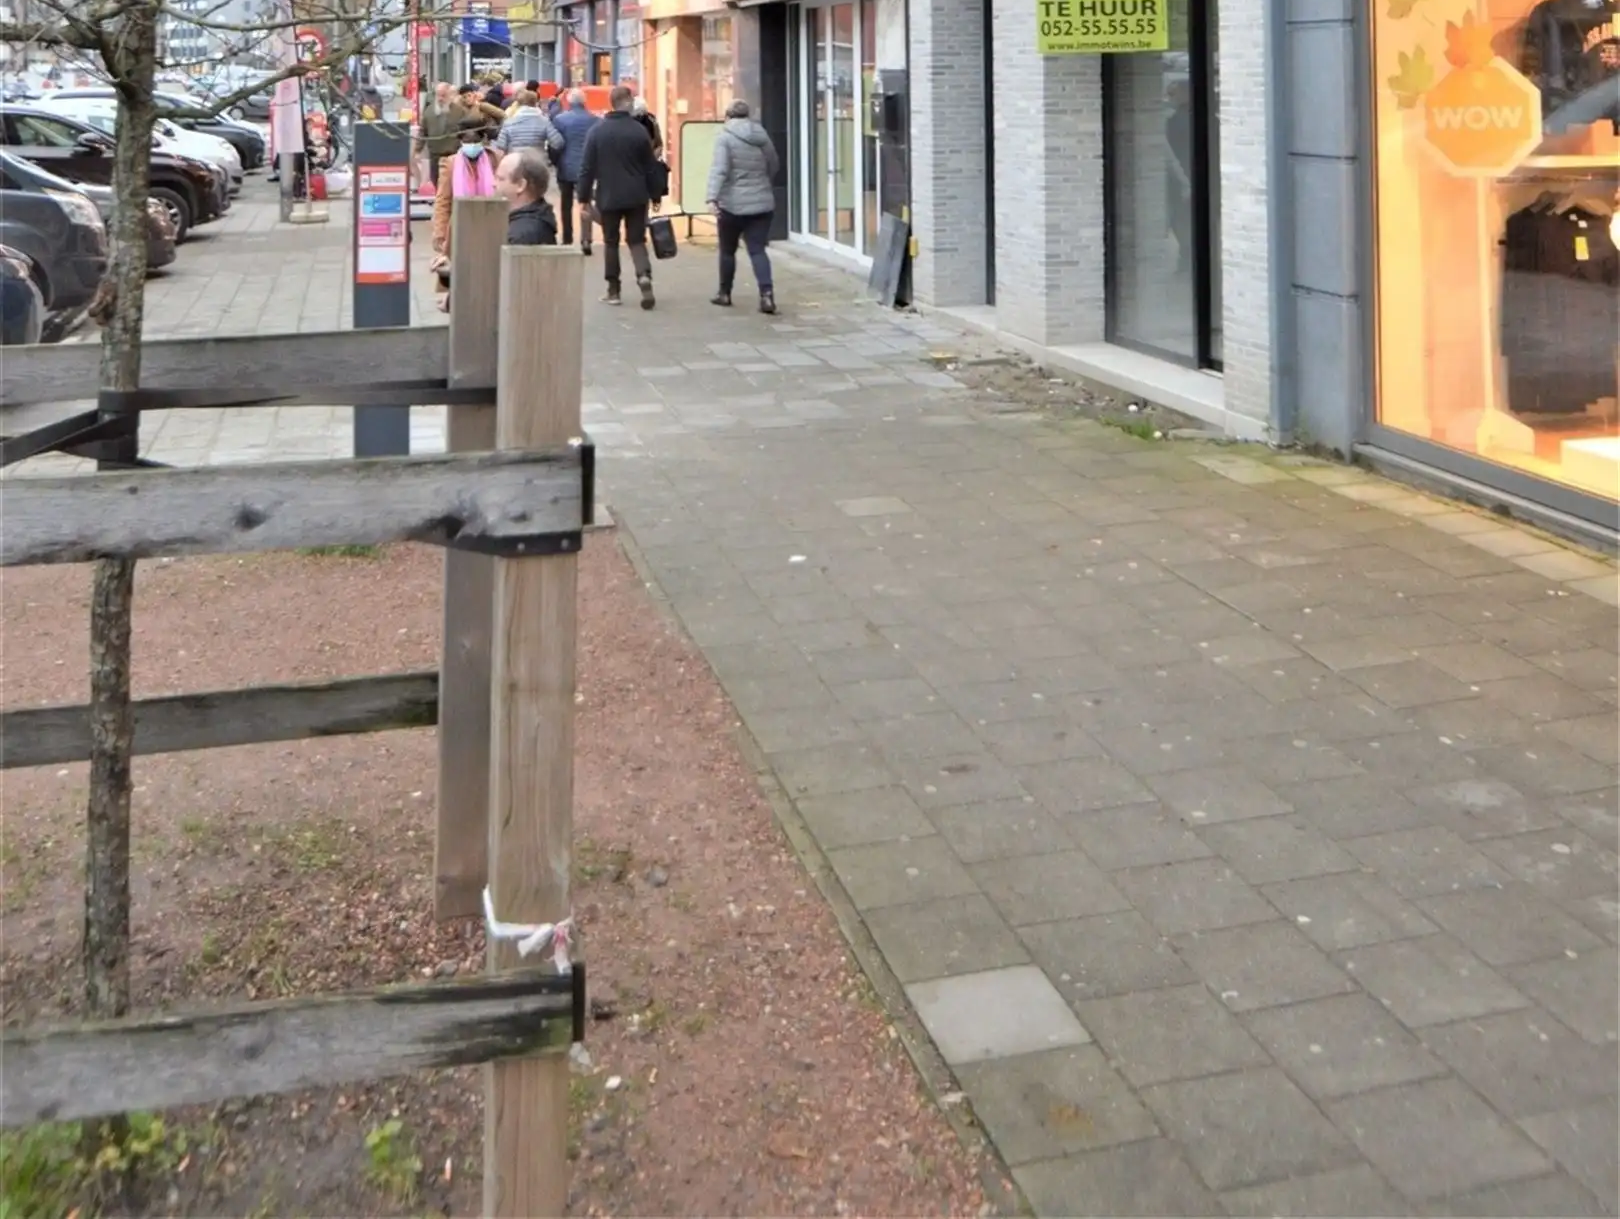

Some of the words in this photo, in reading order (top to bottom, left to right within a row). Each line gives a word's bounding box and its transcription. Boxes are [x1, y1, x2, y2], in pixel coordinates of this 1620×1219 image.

[1040, 1, 1071, 17] TE
[1079, 0, 1157, 17] HUUR
[1041, 18, 1157, 37] 052-55.55.55
[1047, 39, 1152, 51] www.immotwins.be
[1432, 105, 1524, 131] WOW
